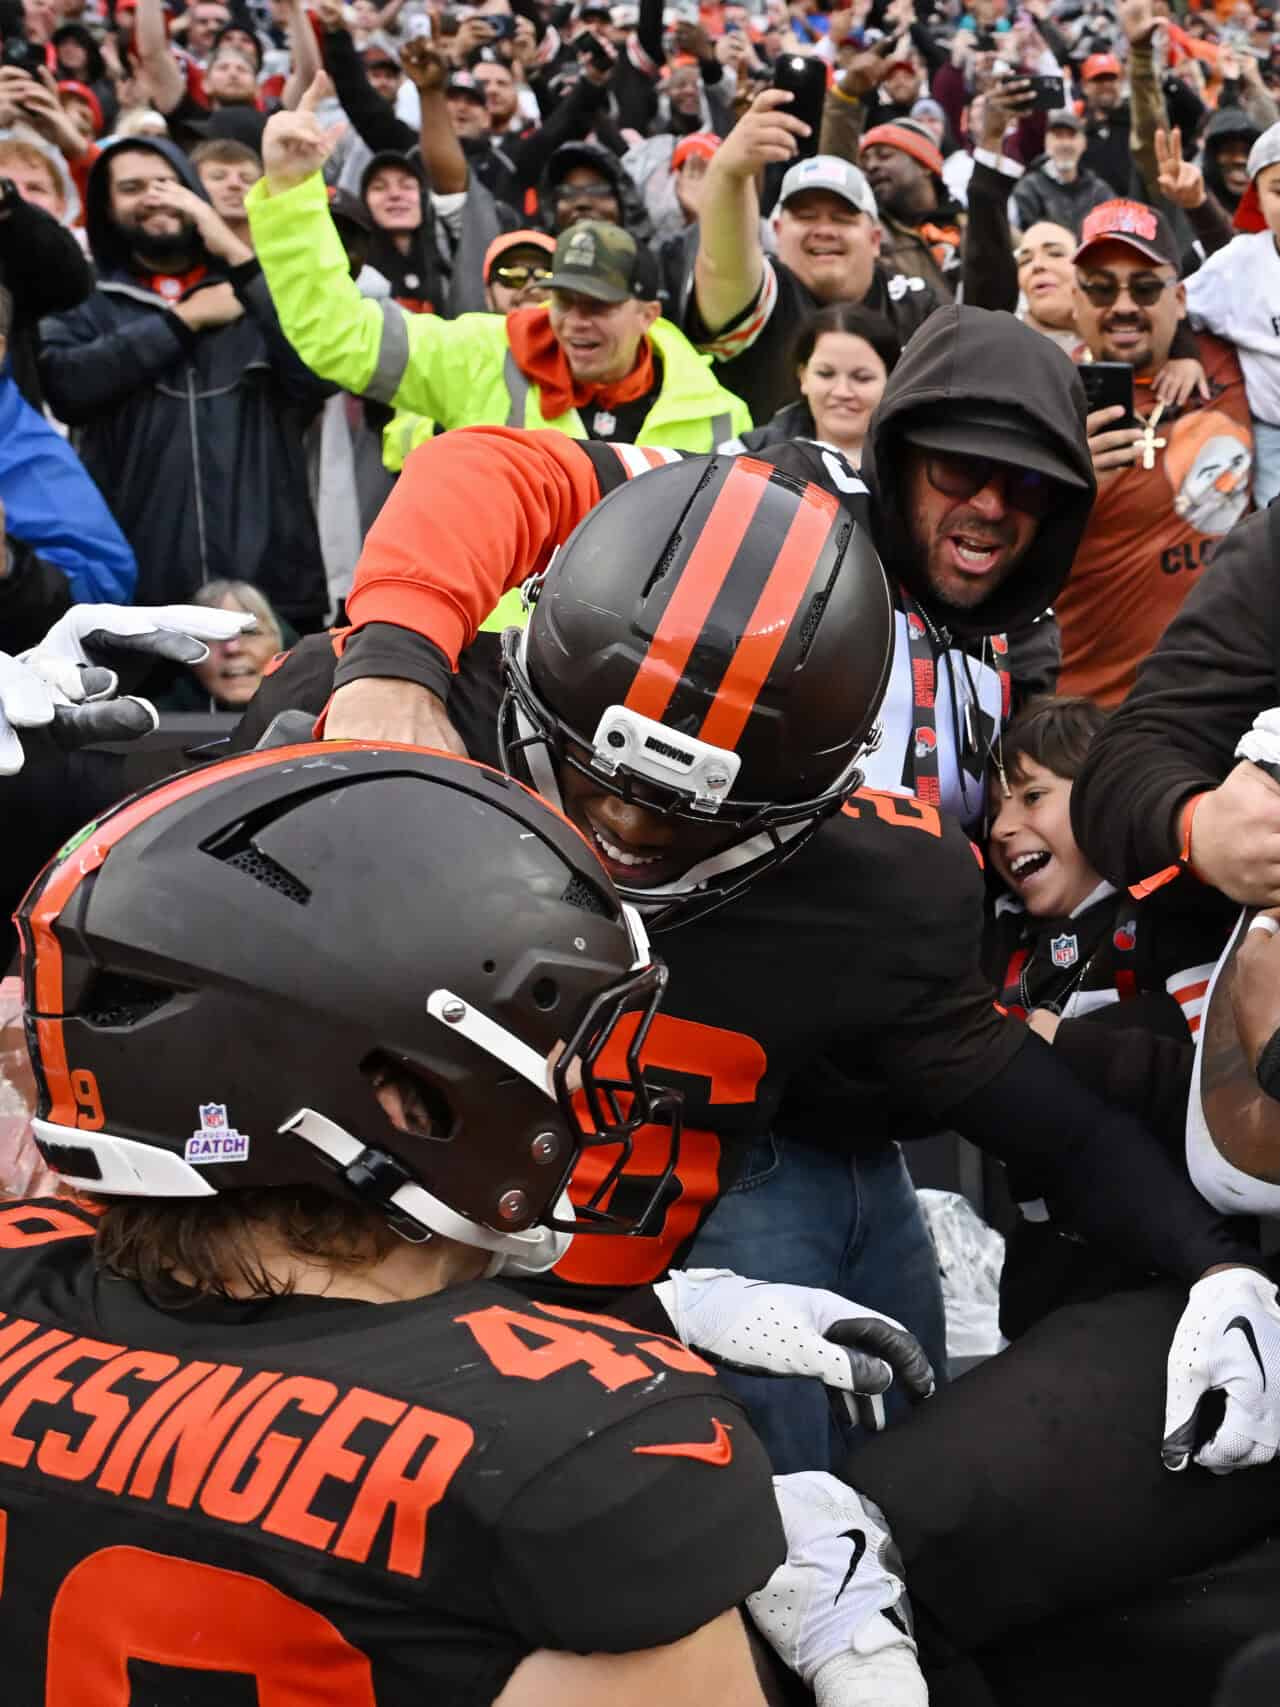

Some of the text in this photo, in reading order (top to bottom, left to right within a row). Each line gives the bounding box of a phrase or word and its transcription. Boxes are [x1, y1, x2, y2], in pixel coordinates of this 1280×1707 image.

[644, 735, 696, 767] BROWNS
[71, 1068, 105, 1131] 9
[190, 1137, 246, 1154] CATCH
